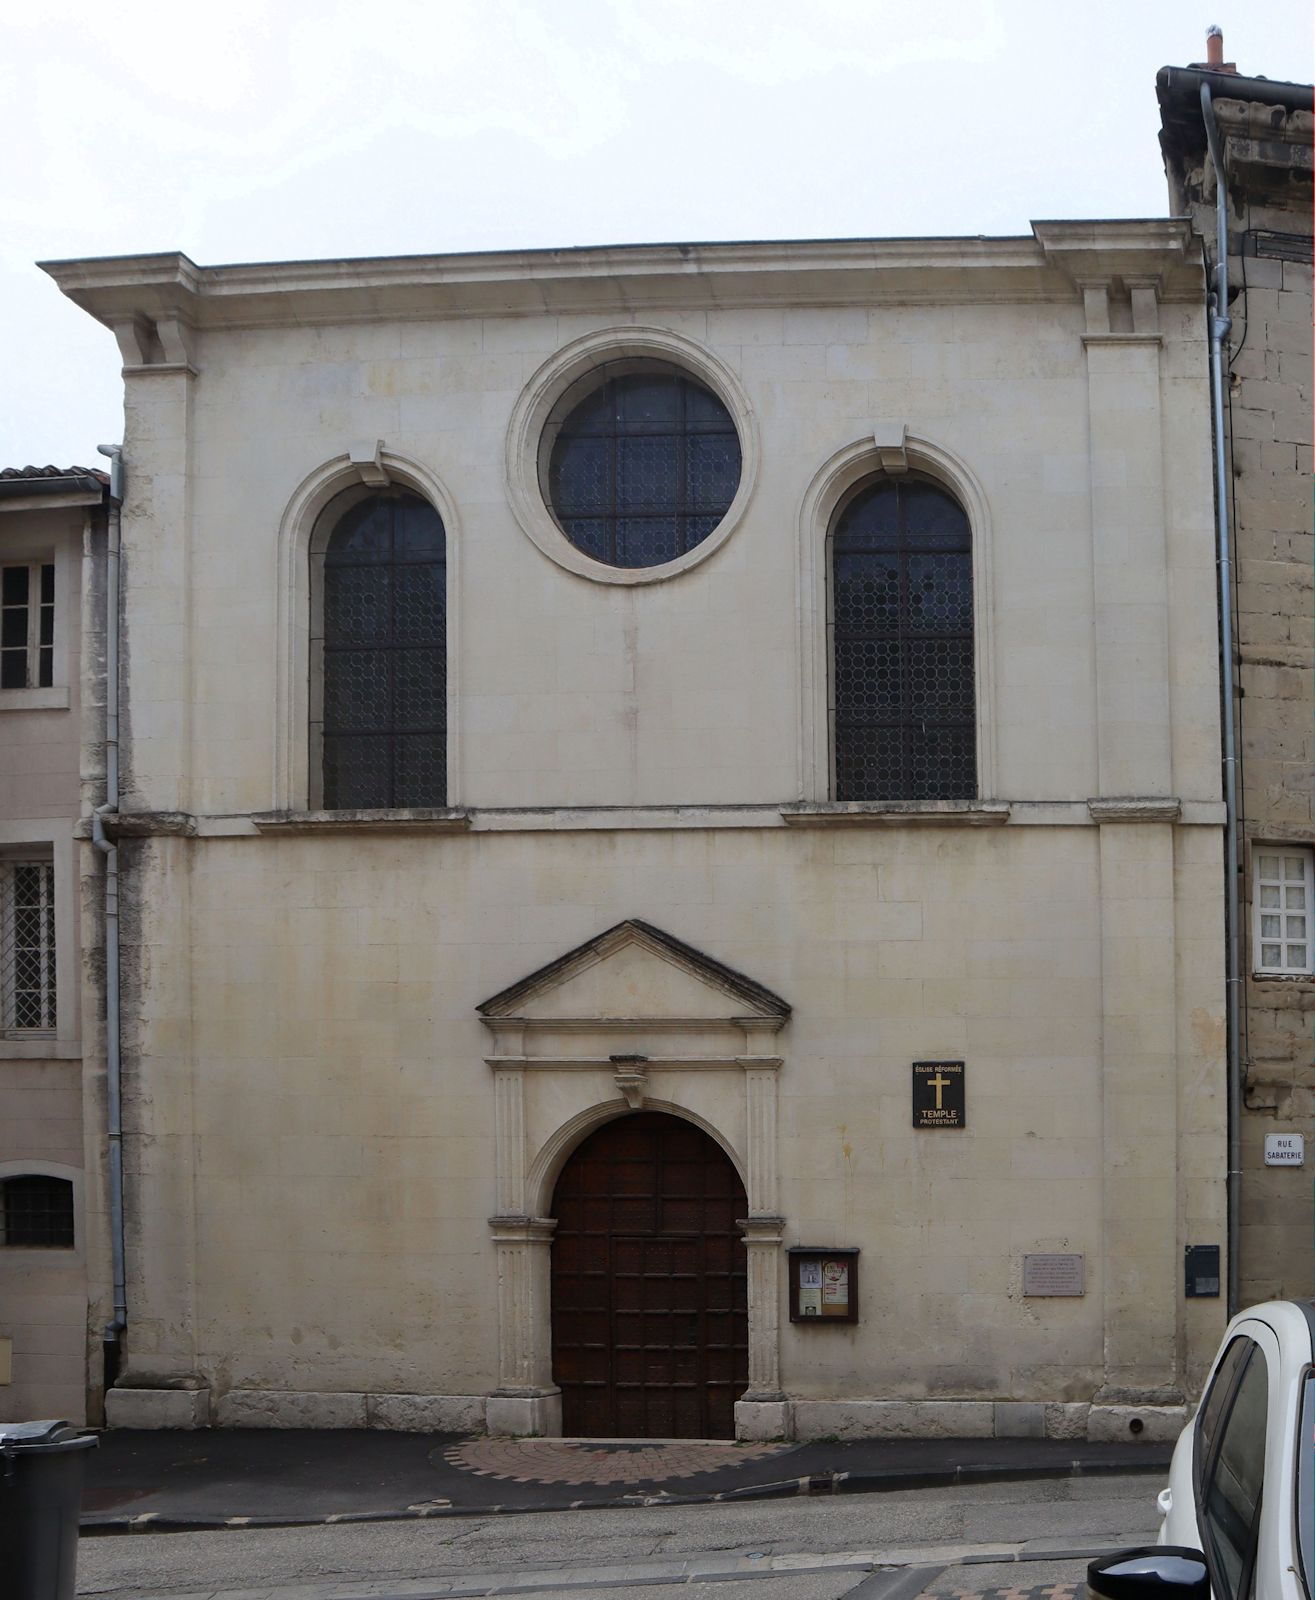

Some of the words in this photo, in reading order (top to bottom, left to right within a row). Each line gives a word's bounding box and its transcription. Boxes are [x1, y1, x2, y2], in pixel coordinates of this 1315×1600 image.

[921, 1110, 957, 1118] TEMPLE
[1277, 1140, 1293, 1148] RUE
[1267, 1151, 1302, 1160] SABATERIE
